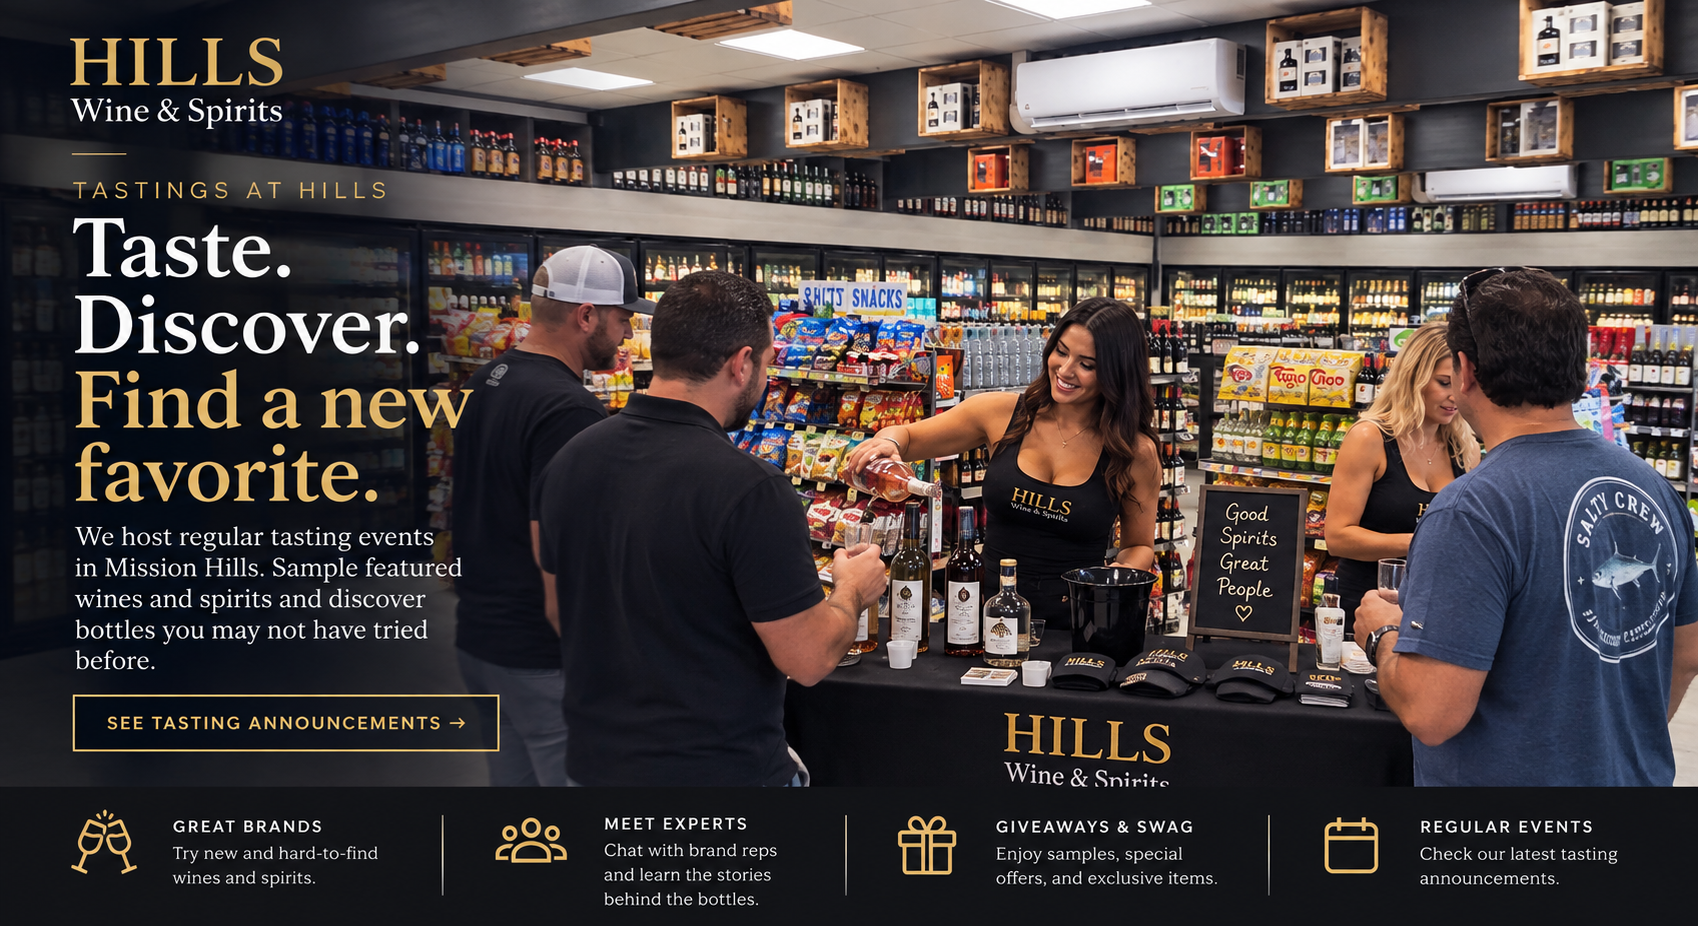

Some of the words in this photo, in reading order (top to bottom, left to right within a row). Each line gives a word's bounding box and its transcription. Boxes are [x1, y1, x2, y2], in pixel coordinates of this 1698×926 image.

[851, 287, 904, 309] SNACKS
[1010, 502, 1031, 513] Wine
[1011, 487, 1072, 515] HILLS
[1225, 502, 1270, 526] Good
[1576, 491, 1609, 549] SALTY
[1614, 491, 1665, 536] CREW
[1219, 526, 1278, 551] Spirits
[1219, 552, 1270, 575] Great
[1216, 576, 1274, 602] People
[1003, 712, 1172, 765] HILLS
[1003, 761, 1065, 786] Wine
[1070, 767, 1089, 788] &
